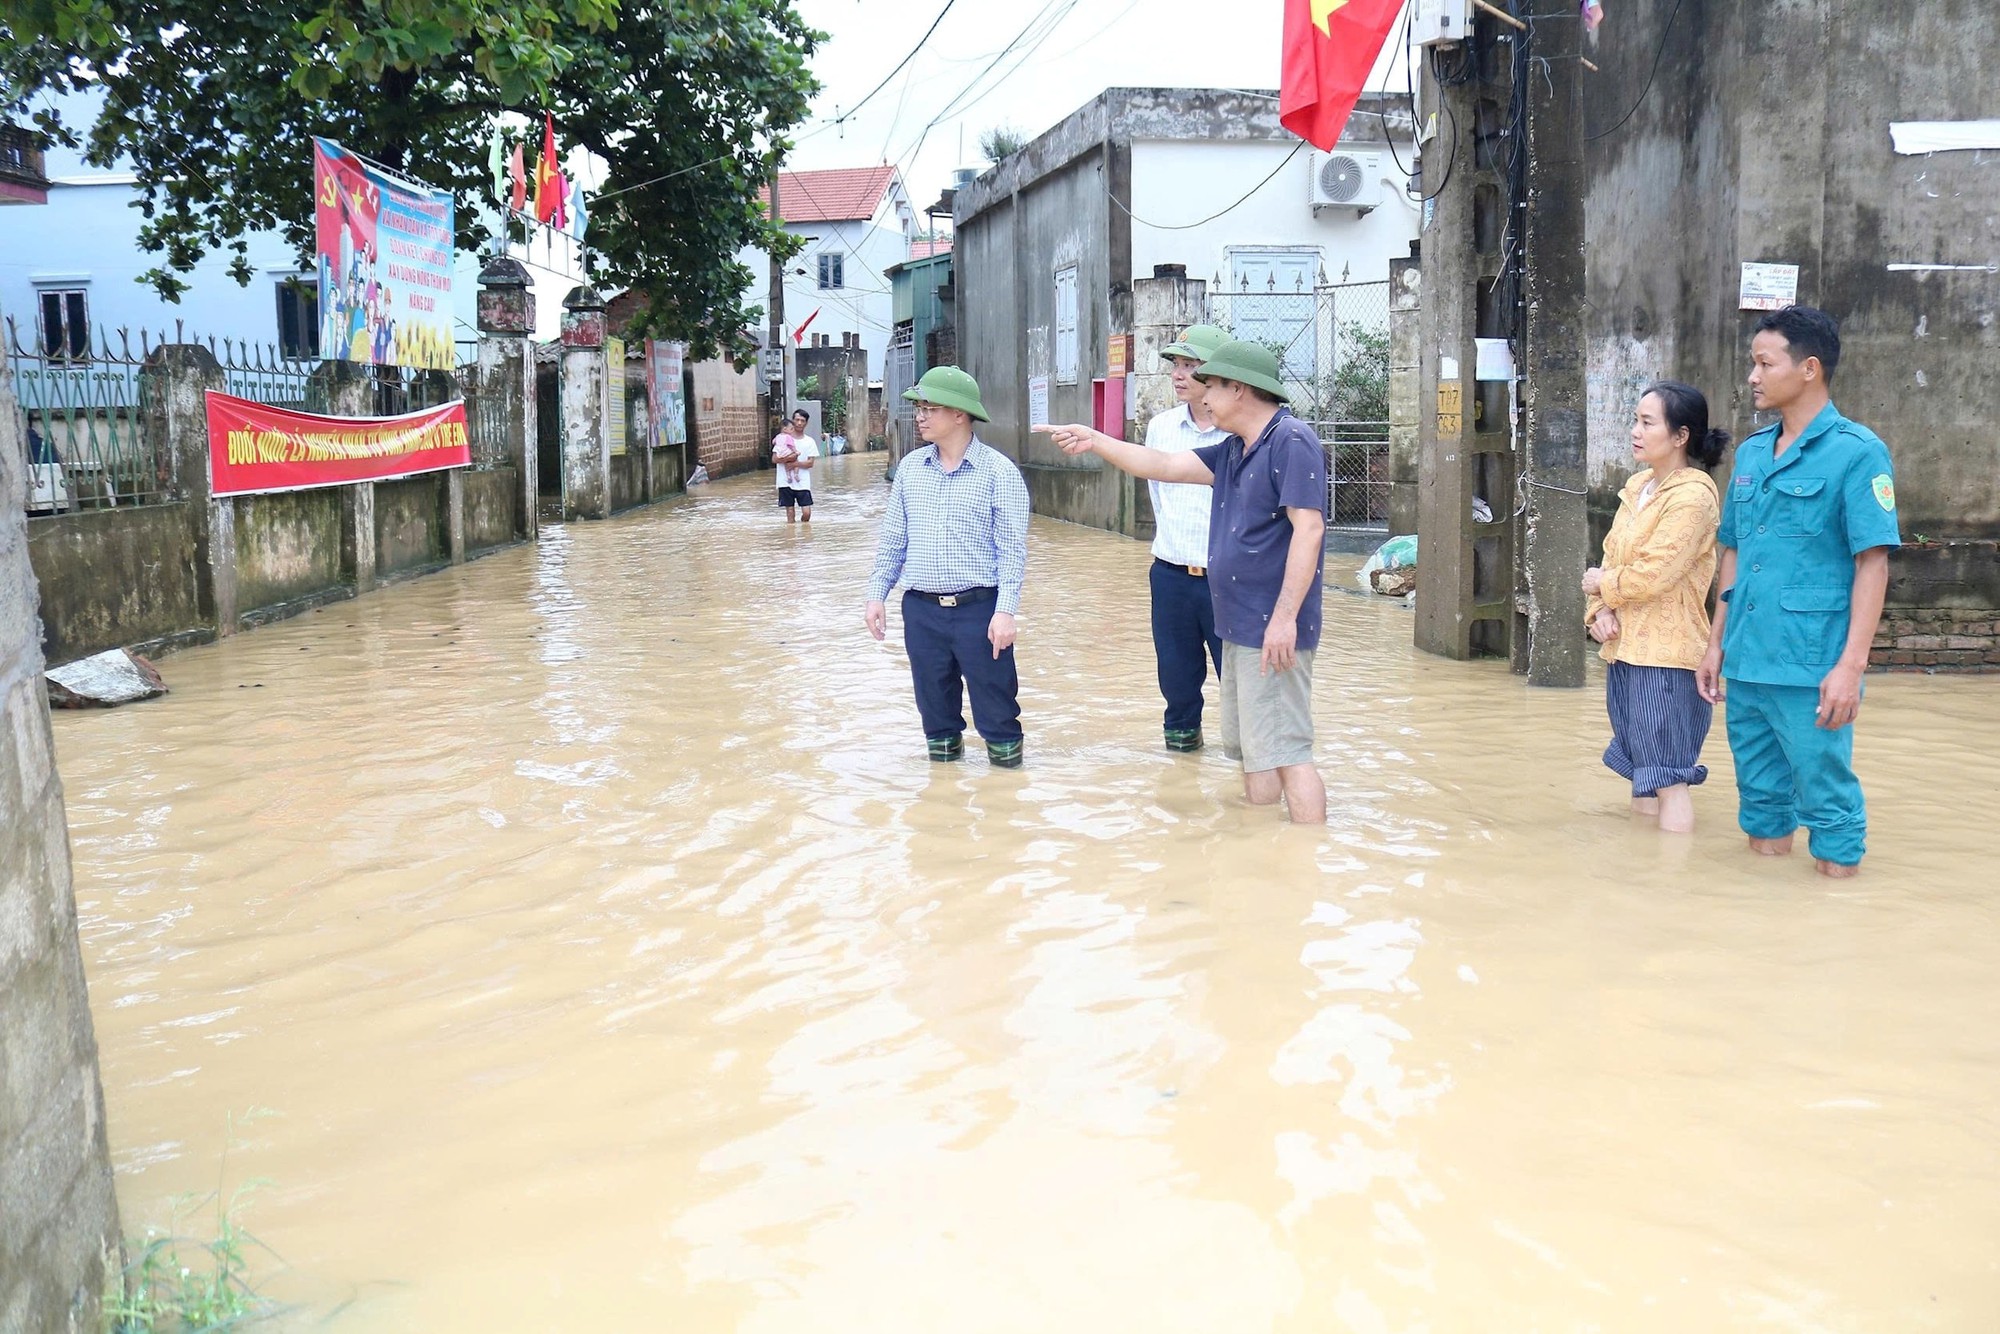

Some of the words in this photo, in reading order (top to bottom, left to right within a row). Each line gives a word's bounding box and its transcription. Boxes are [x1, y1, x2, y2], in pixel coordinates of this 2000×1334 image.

[228, 420, 256, 464] ĐUỐI
[257, 426, 290, 463] NƯỚC
[289, 427, 306, 462] LÀ
[452, 422, 468, 446] EM
